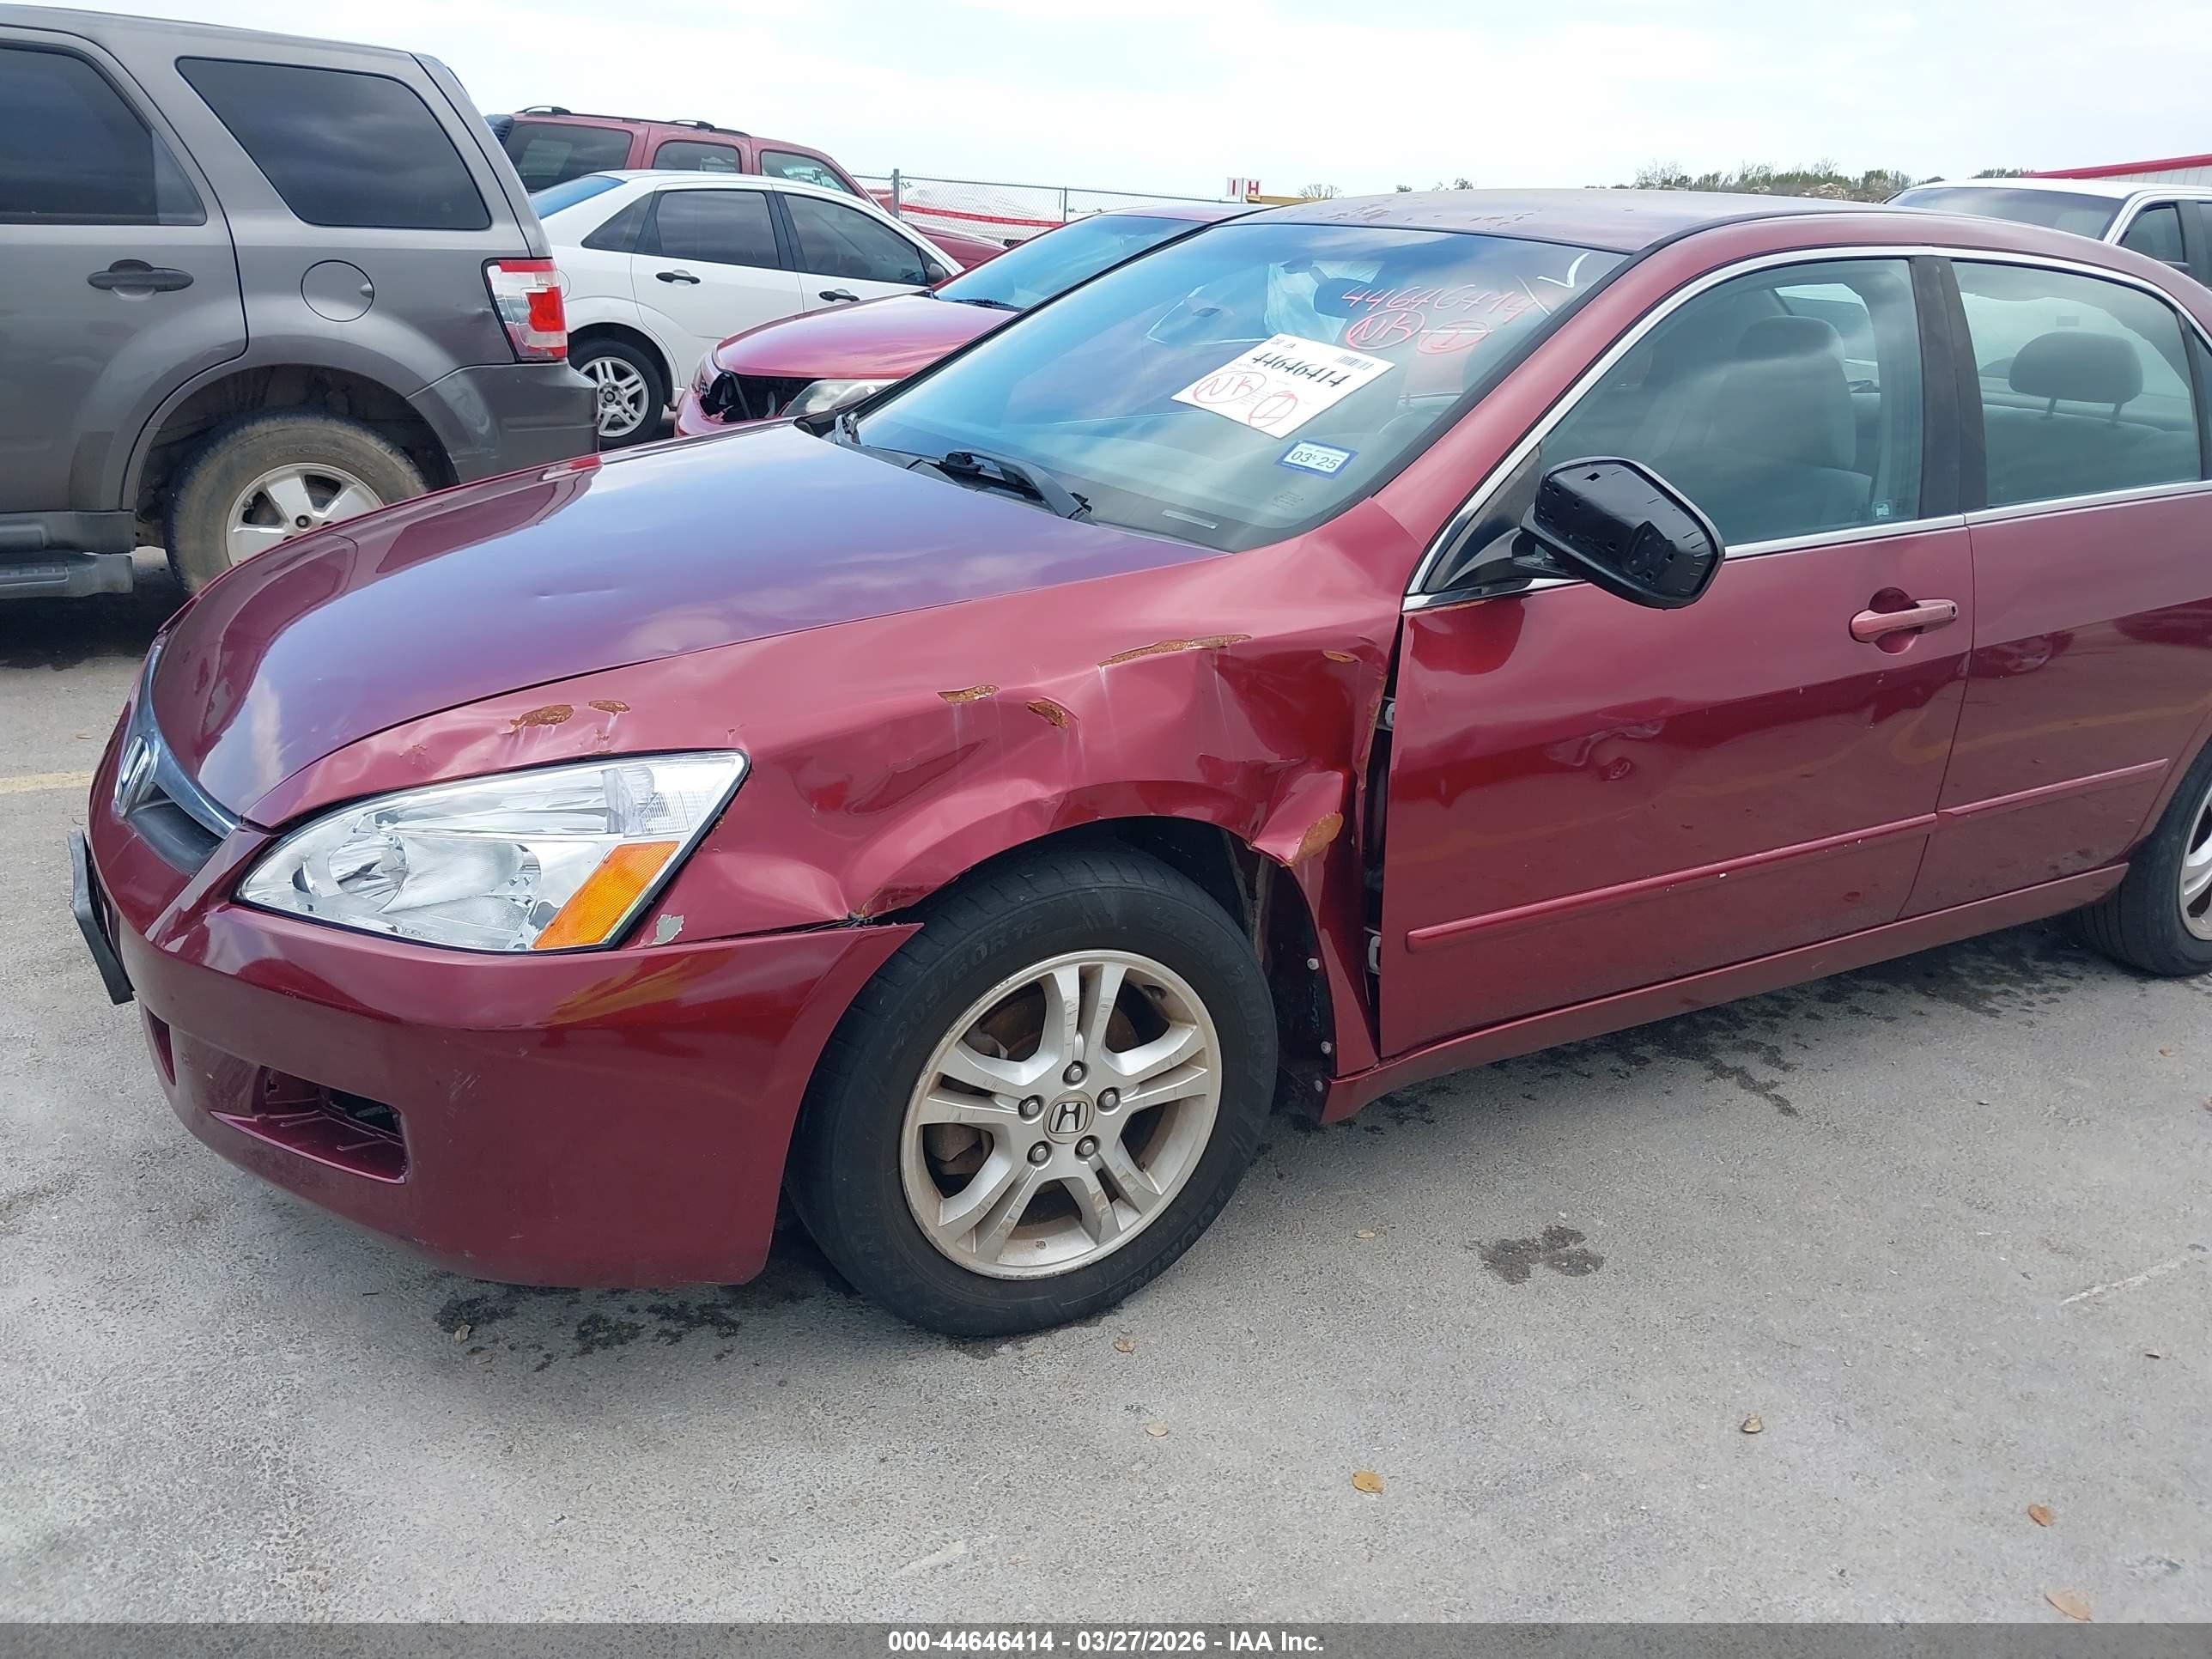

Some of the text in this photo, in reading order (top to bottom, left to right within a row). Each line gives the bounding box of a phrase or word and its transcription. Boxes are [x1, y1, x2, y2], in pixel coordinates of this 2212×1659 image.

[1248, 180, 1260, 195] H
[1341, 283, 1526, 325] 44646414
[1252, 352, 1352, 388] 44646414
[1197, 375, 1255, 397] NK
[1291, 451, 1312, 463] 03
[1316, 456, 1340, 469] 25
